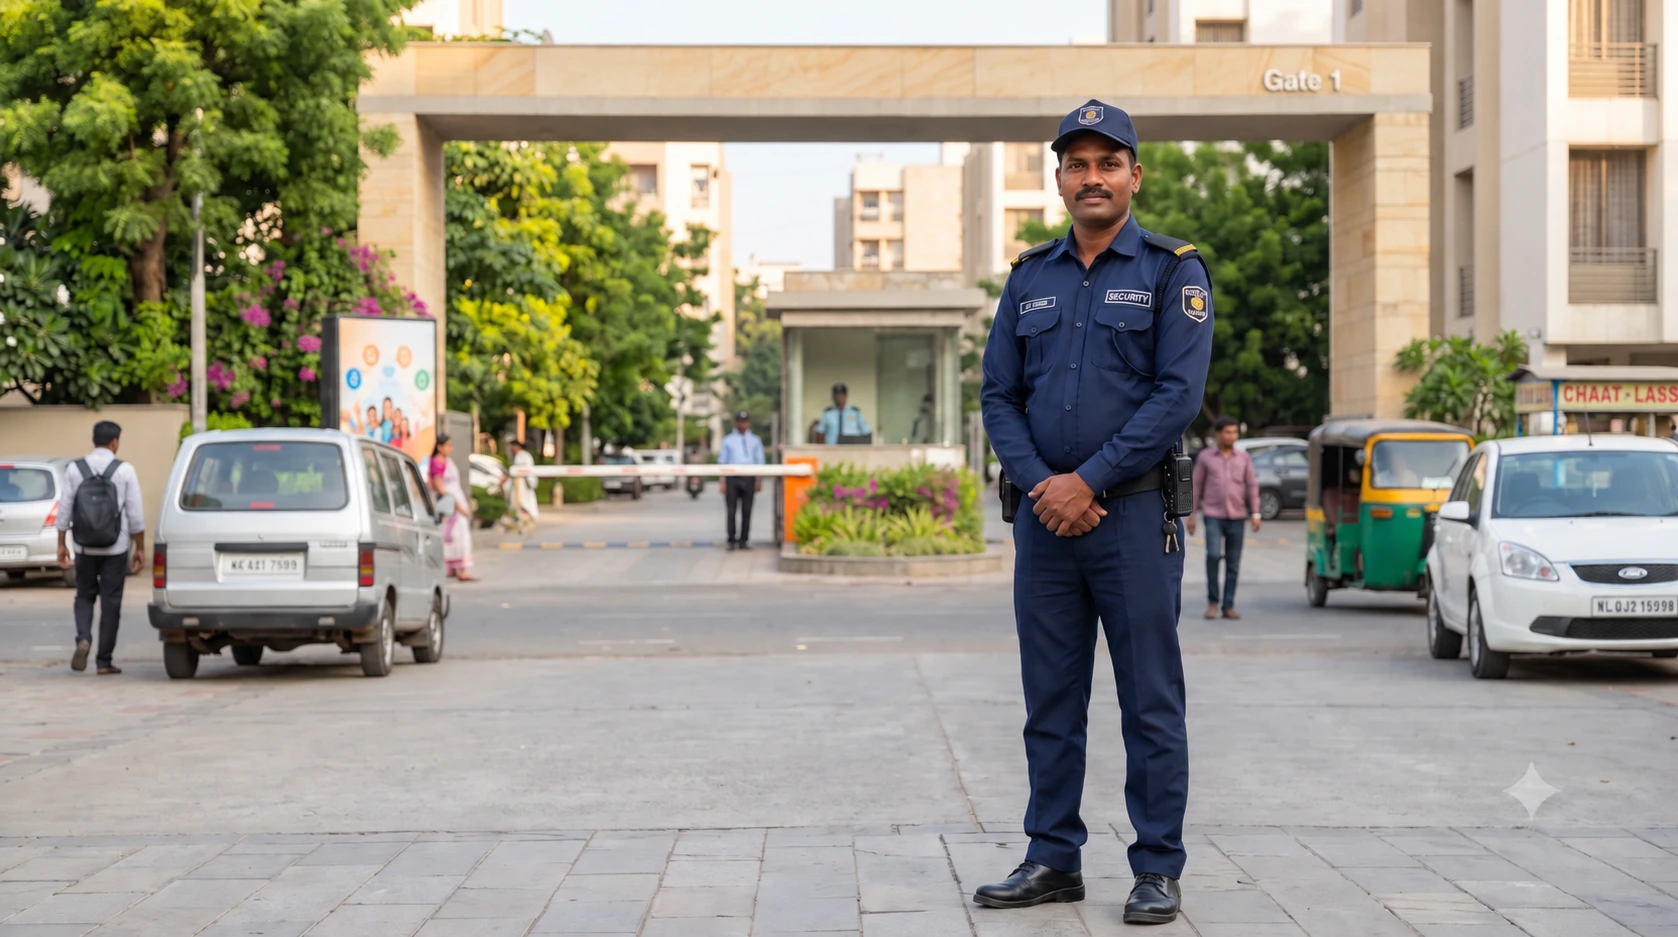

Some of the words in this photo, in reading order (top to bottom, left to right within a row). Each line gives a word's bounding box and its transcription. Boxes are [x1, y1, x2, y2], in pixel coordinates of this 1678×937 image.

[1263, 68, 1322, 92] Gate
[1328, 69, 1341, 92] 1
[1108, 292, 1149, 304] SECURITY
[1563, 384, 1623, 403] CHAAT
[1634, 384, 1678, 404] LASS
